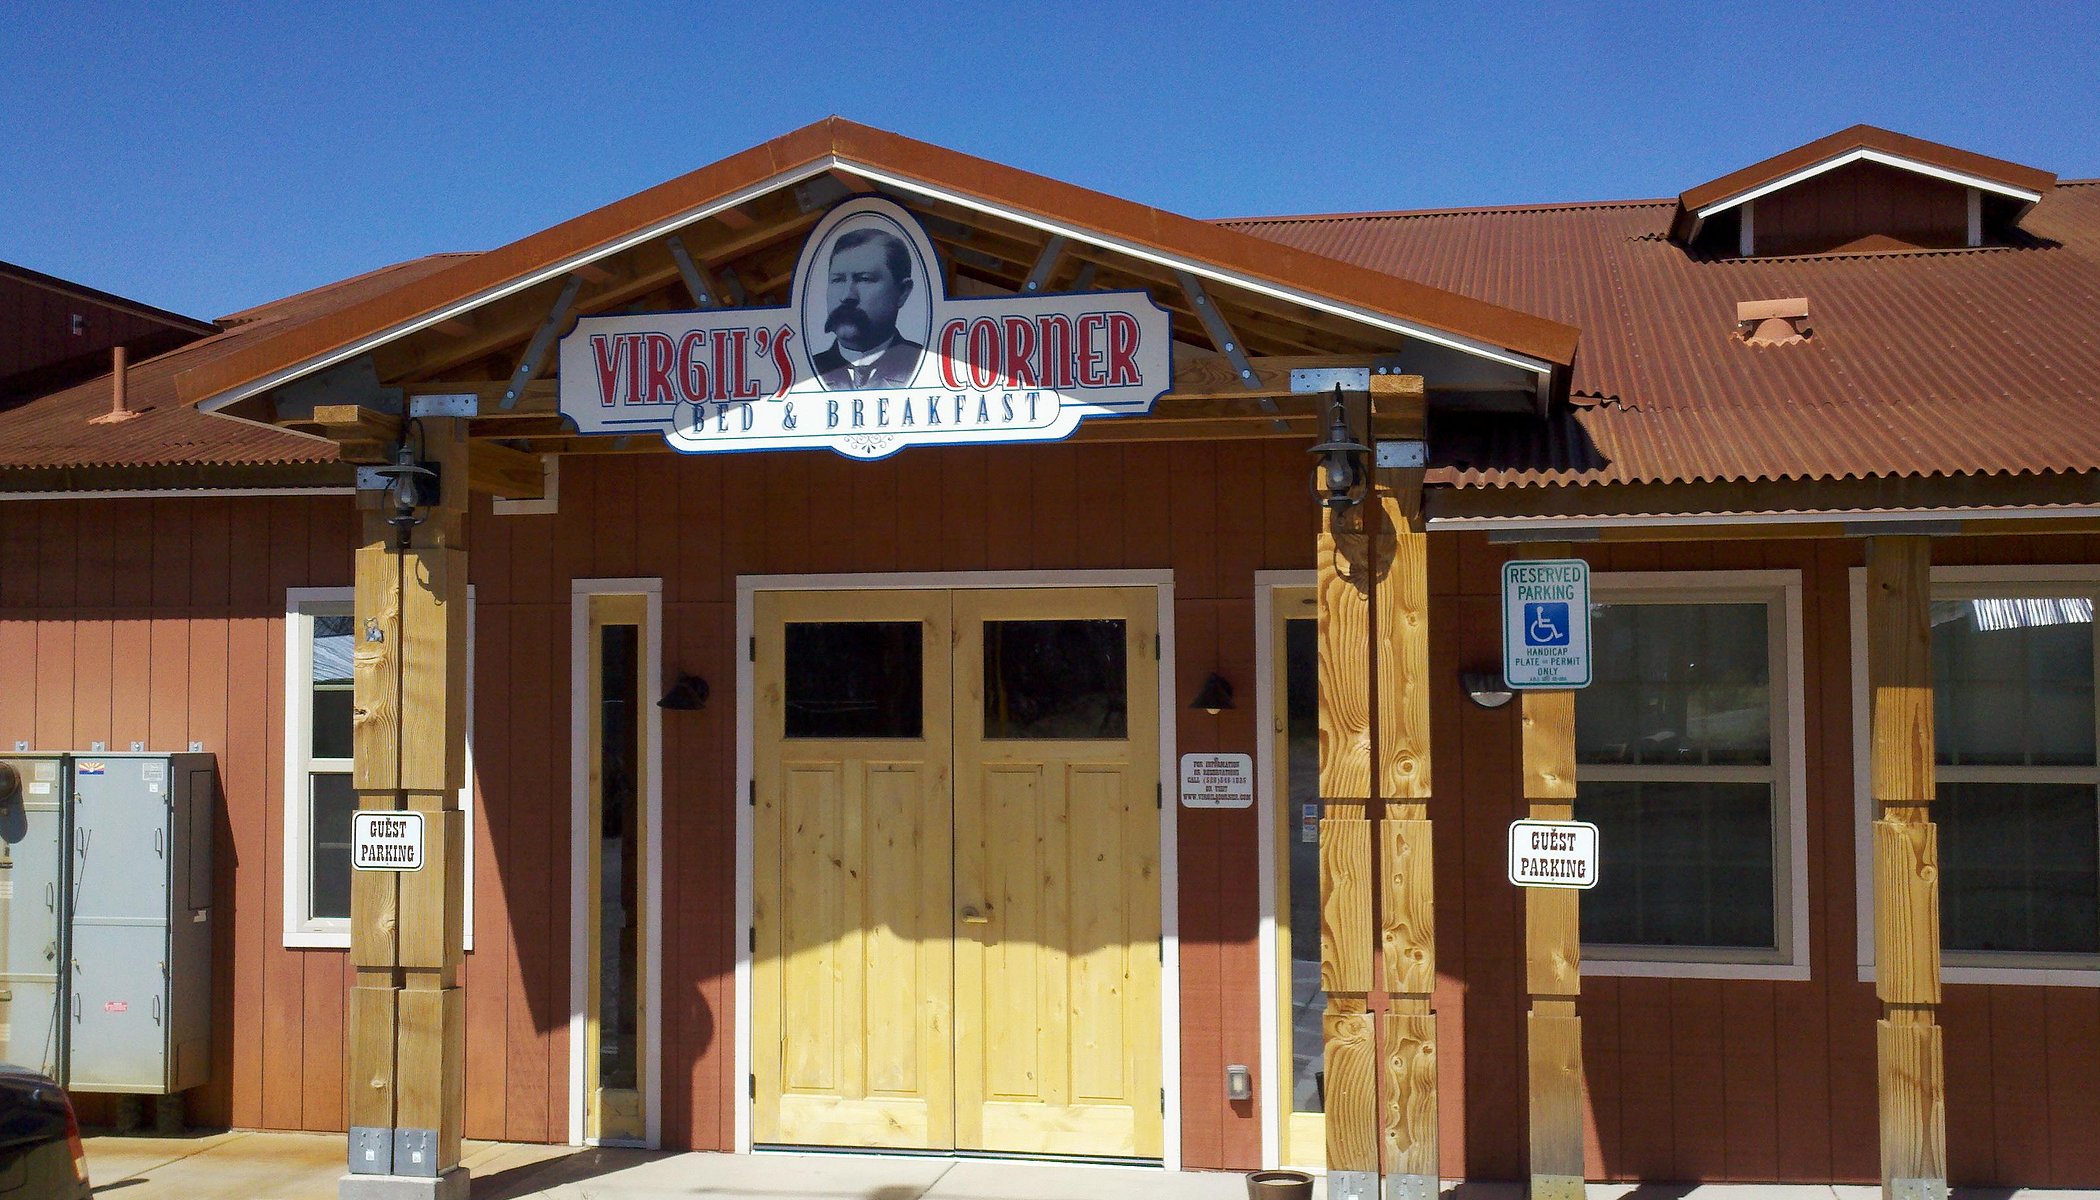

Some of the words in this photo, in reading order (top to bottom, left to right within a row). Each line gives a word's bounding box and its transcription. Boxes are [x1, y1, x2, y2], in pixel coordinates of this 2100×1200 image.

[590, 324, 796, 408] VIRGIL'S
[937, 310, 1143, 392] CORNER
[692, 402, 754, 434] BED
[782, 401, 798, 431] &
[825, 391, 1043, 430] BREAKFAST
[1510, 567, 1581, 583] RESERVED
[1518, 585, 1575, 600] PARKING
[1526, 647, 1568, 656] HANDICAP
[1515, 658, 1540, 666] PLATE
[1550, 657, 1580, 665] PERMIT
[1537, 668, 1559, 676] ONLY
[370, 820, 407, 838] GUEST
[1531, 831, 1577, 852] GUEST
[361, 844, 414, 862] PARKING
[1520, 857, 1586, 879] PARKING
